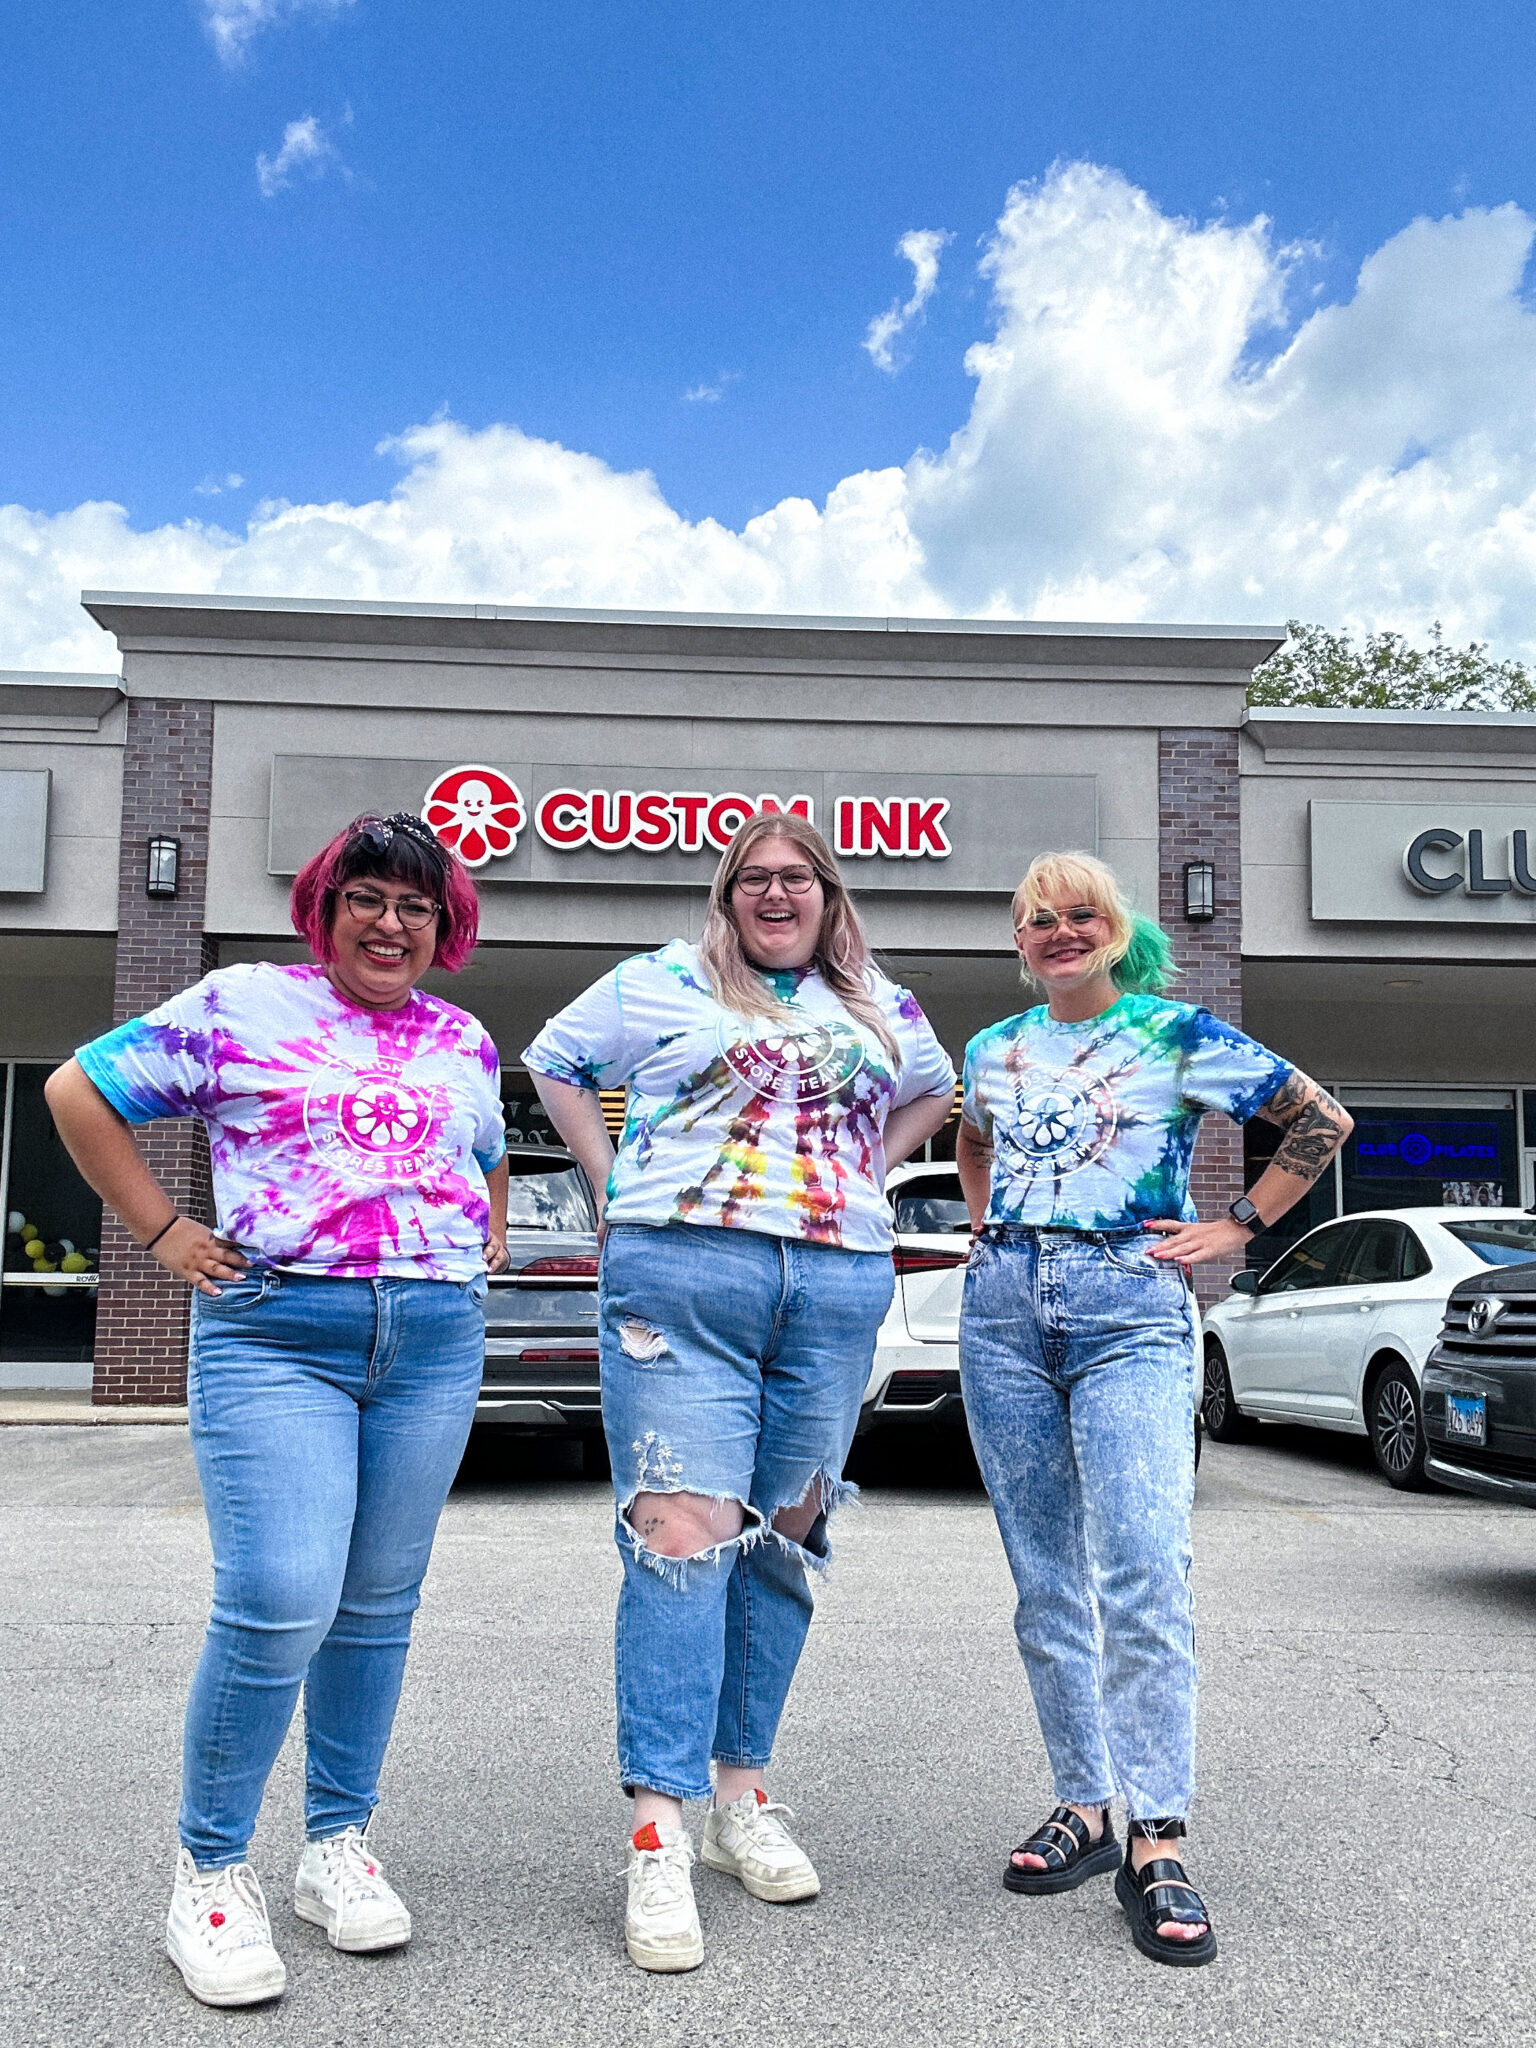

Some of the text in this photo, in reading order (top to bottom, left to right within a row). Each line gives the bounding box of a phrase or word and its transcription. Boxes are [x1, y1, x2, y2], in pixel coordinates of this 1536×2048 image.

[836, 798, 952, 857] INK
[735, 1047, 844, 1092] STORES TEAM
[321, 1130, 437, 1173] STORES TEAM
[1357, 1143, 1495, 1158] CLUB PILATES
